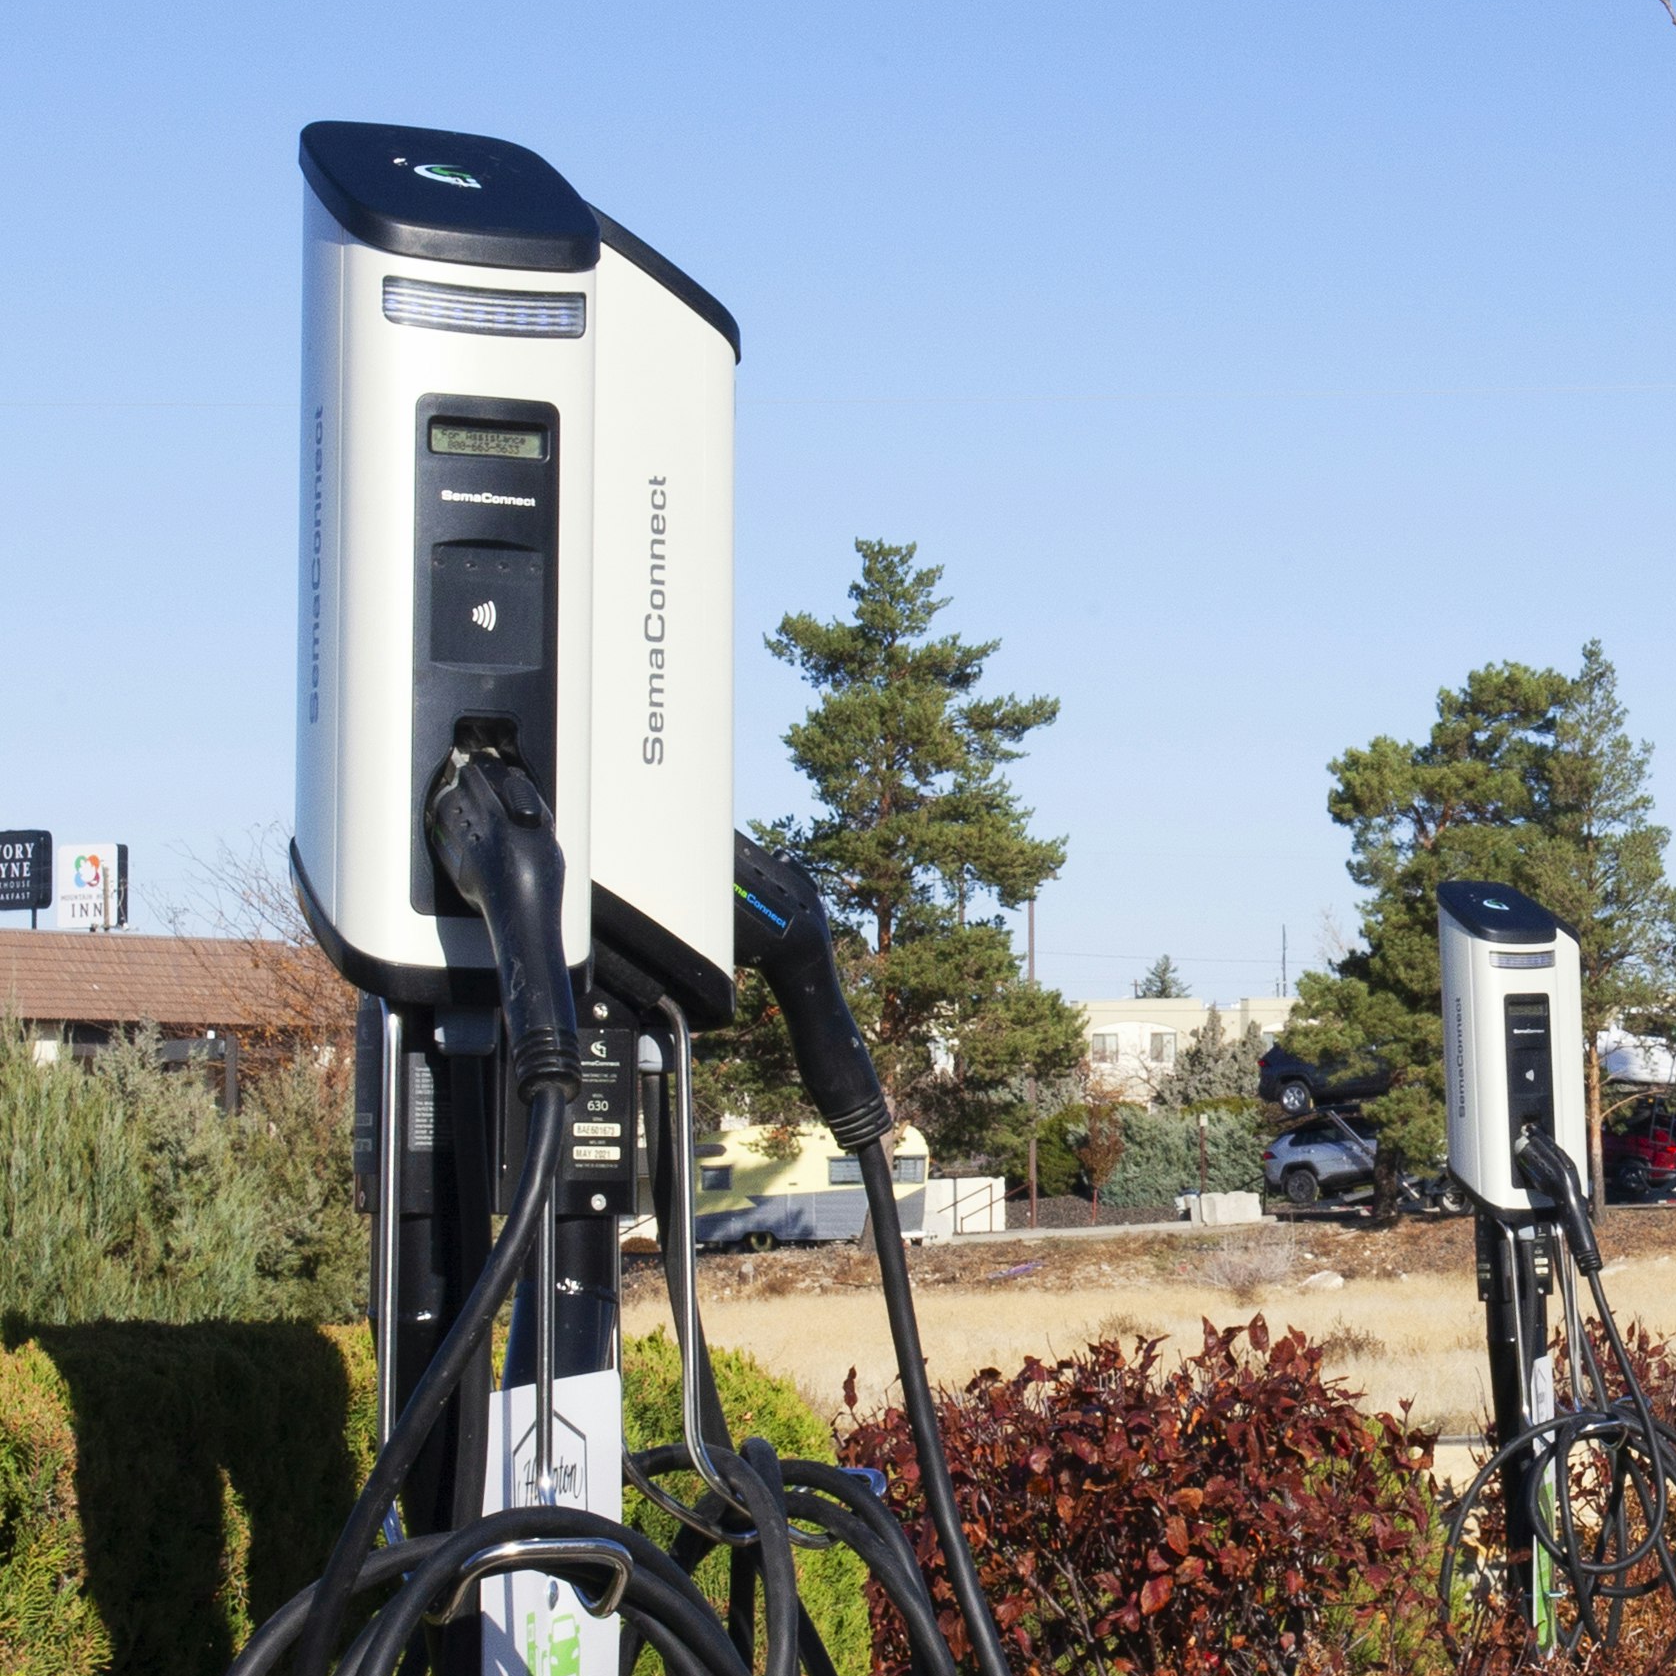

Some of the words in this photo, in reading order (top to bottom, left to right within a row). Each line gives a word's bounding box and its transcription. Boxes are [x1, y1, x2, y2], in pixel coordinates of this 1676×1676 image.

[441, 489, 537, 507] SemaConnect
[308, 405, 324, 725] SemaConnect
[643, 475, 668, 766] SemaConnect
[0, 842, 35, 860] ORY
[71, 902, 104, 919] INN
[733, 882, 788, 929] maConnect
[1455, 996, 1467, 1119] SemaConnect
[586, 1100, 610, 1112] 630
[575, 1148, 592, 1160] MAY
